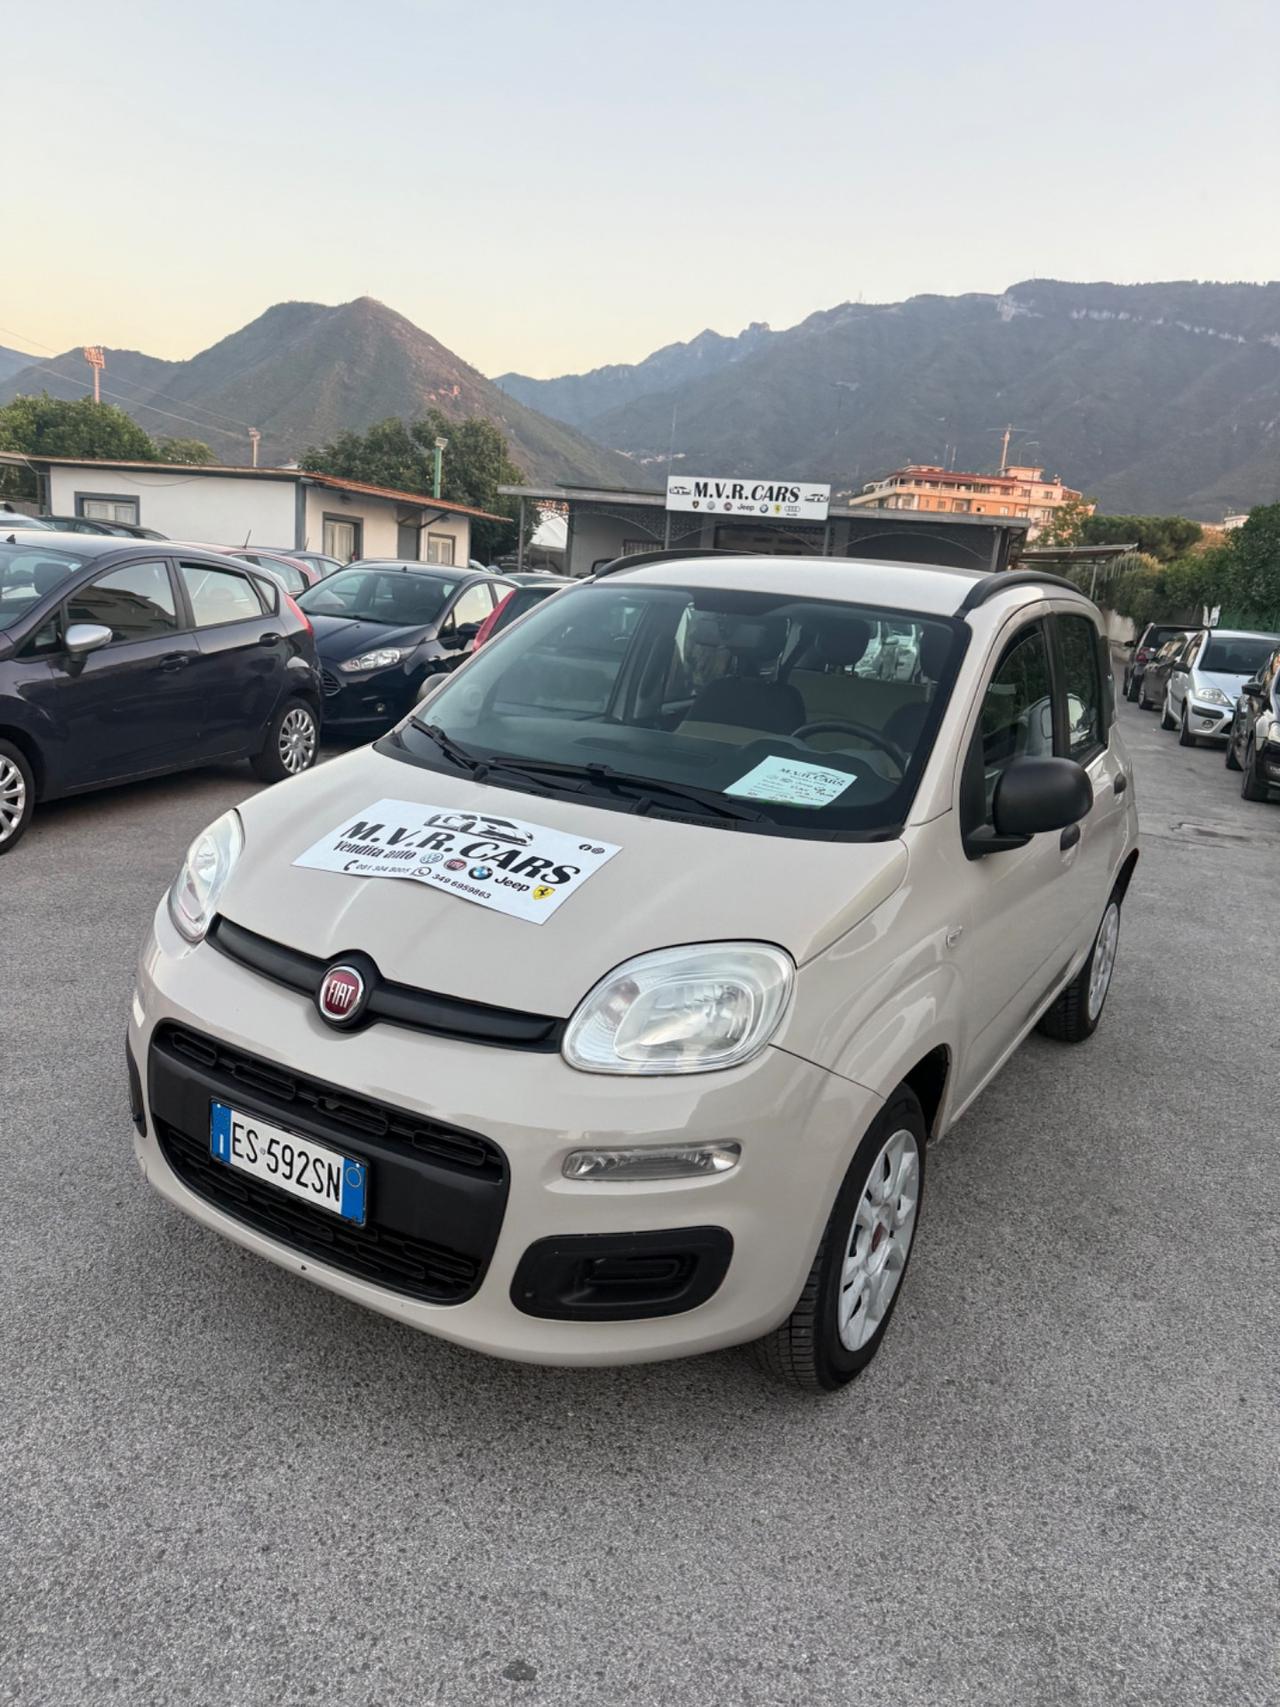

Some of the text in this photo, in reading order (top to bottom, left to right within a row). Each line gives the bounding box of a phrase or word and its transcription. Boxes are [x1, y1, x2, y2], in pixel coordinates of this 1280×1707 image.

[737, 503, 755, 512] Jeep
[333, 840, 417, 860] Vendita auto
[432, 873, 451, 884] 349
[494, 876, 530, 893] Jeep
[327, 980, 355, 1008] FIAT
